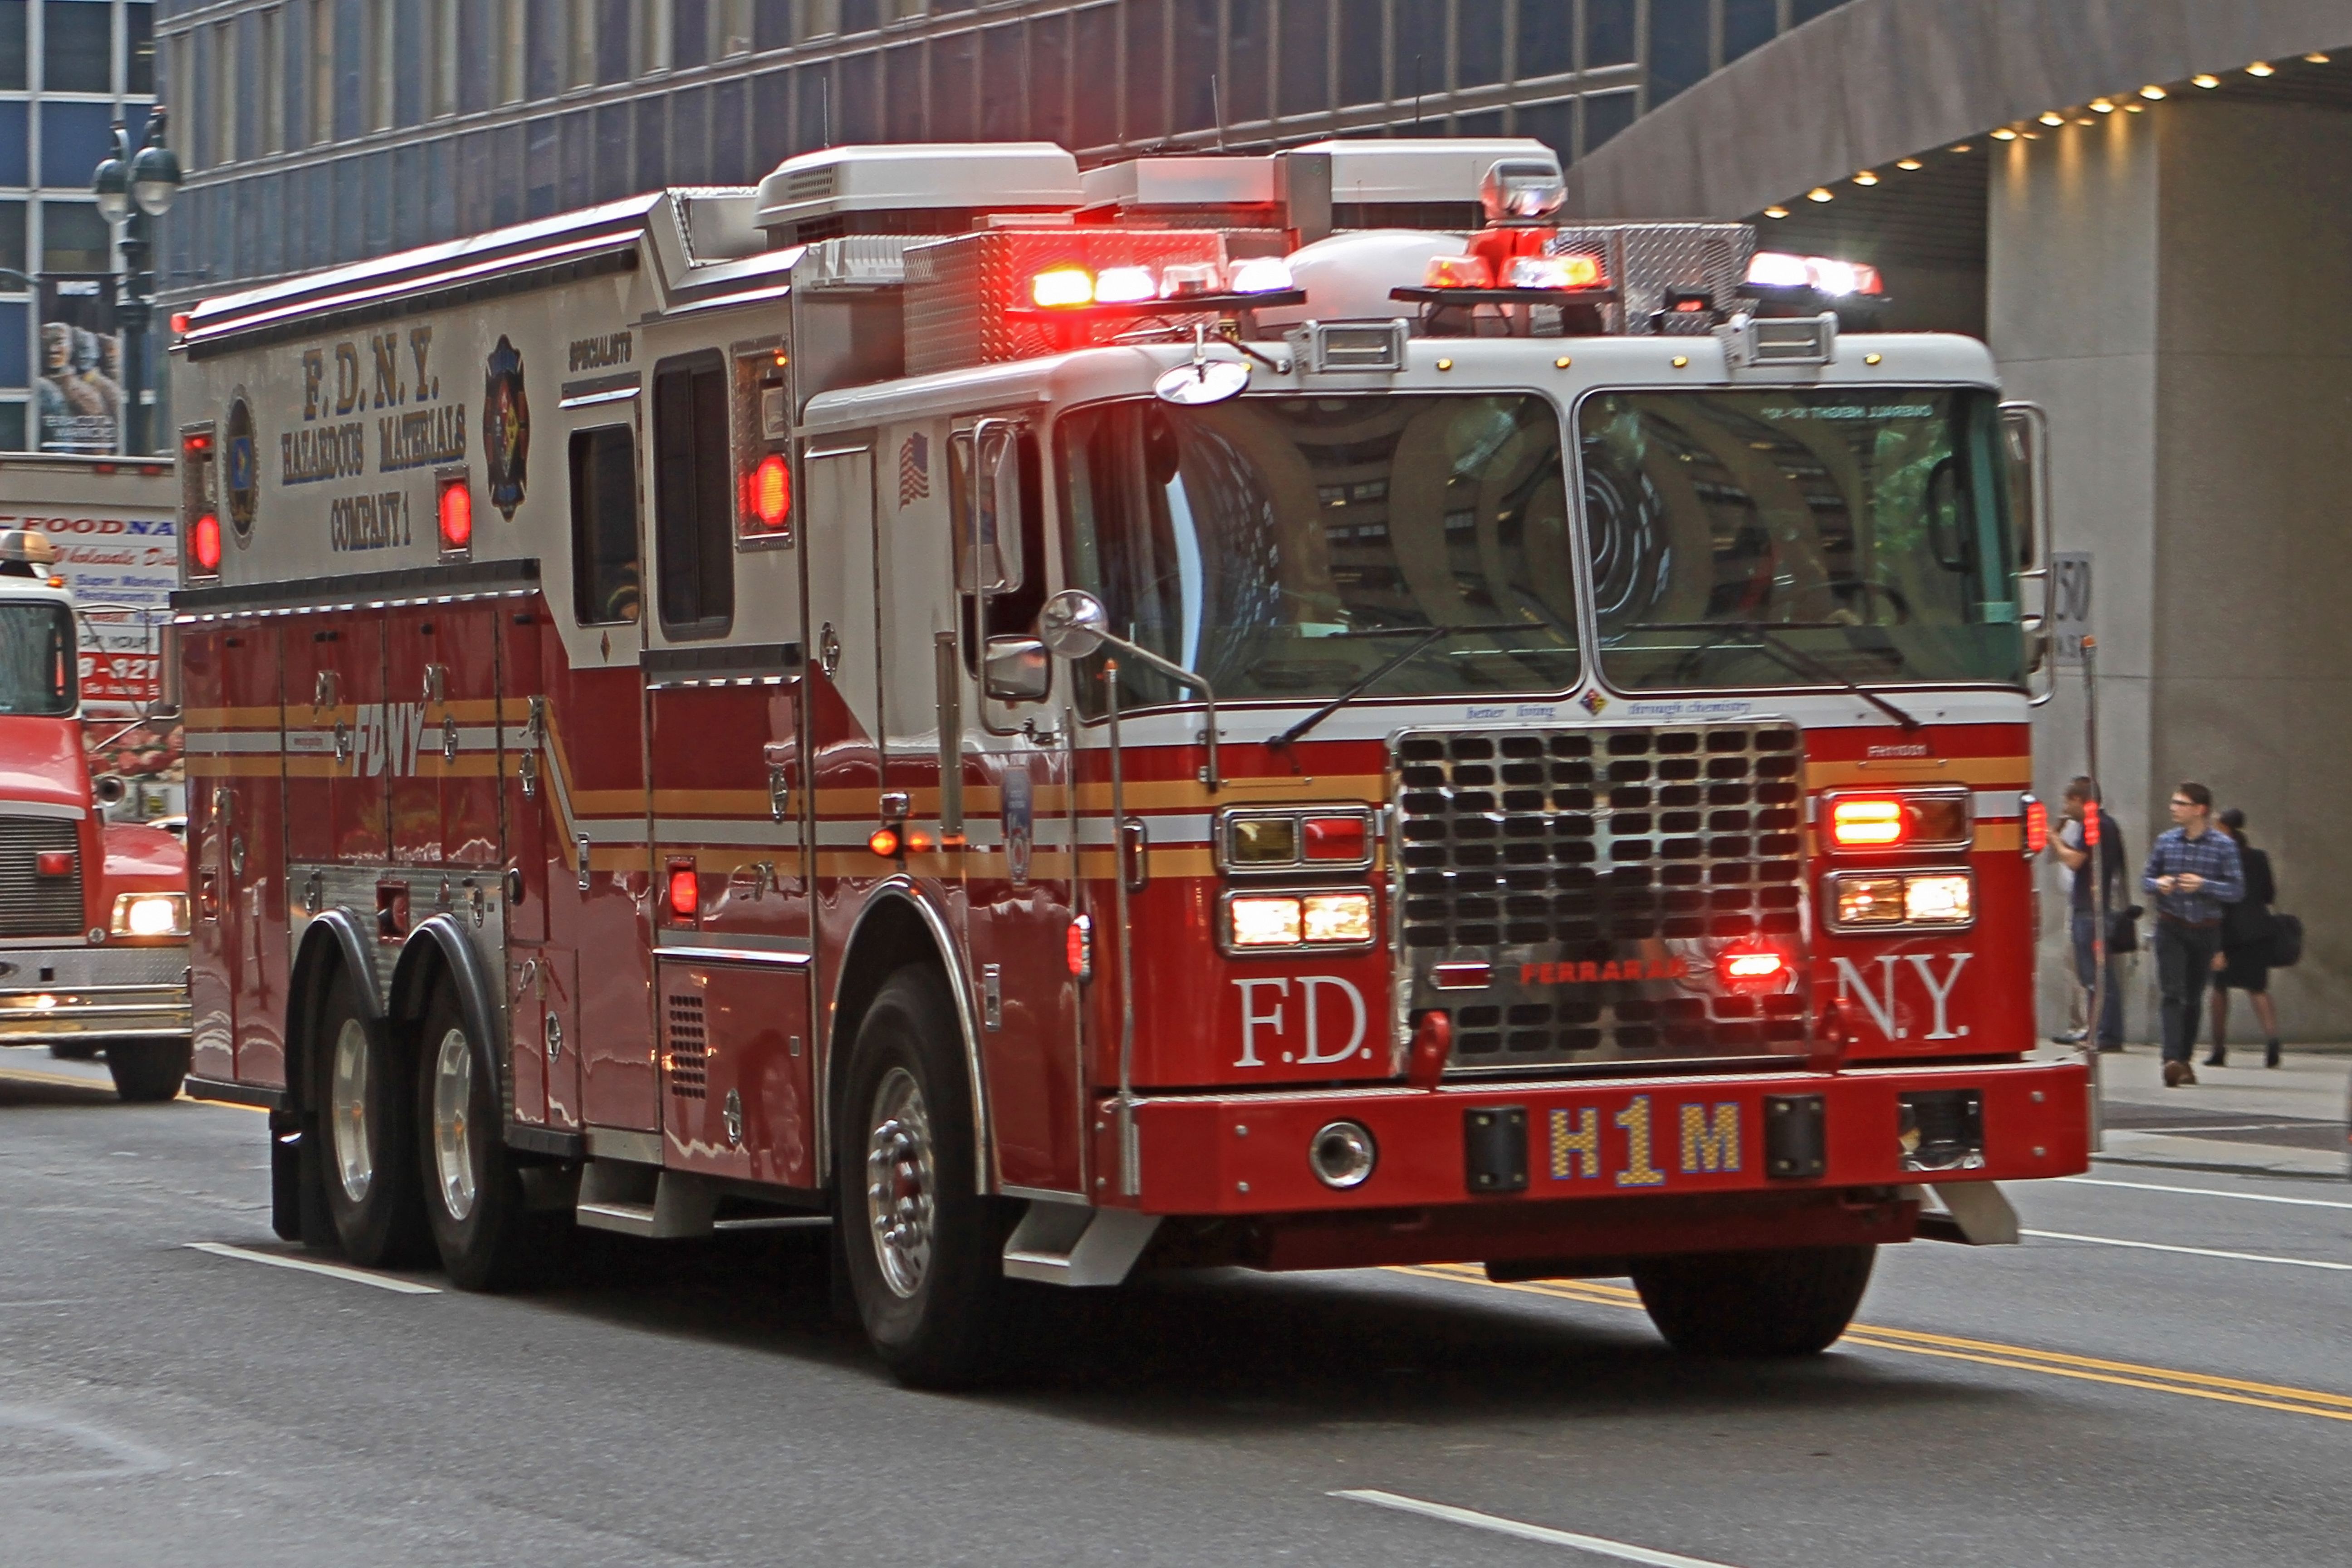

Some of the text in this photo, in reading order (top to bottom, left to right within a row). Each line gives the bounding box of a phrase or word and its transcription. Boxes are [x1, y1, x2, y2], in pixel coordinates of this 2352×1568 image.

[281, 403, 466, 486] HAZARDOUS MATERIALS
[331, 490, 412, 552] COMPANY 1
[352, 702, 427, 777] FDNY
[1231, 952, 1974, 1067] F.D. N.Y.
[1521, 959, 1664, 985] FERRARA
